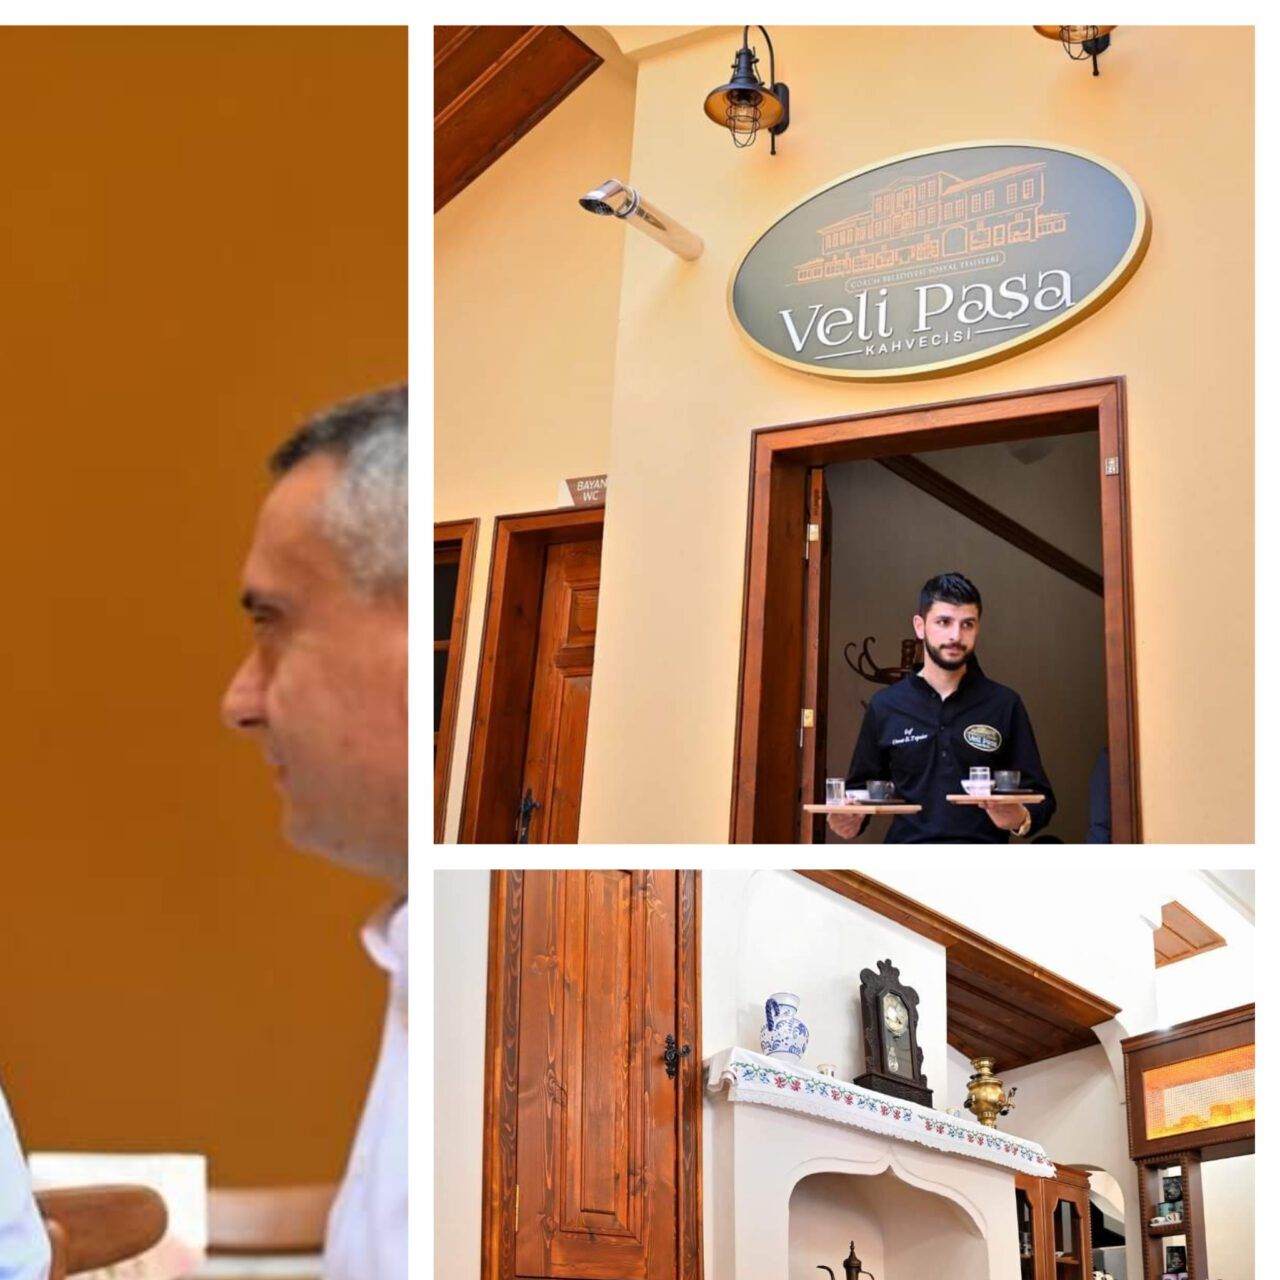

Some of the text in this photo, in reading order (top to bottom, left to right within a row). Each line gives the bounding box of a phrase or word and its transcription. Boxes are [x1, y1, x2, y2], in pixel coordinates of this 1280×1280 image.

[778, 288, 894, 353] Veli
[577, 478, 608, 492] BAYAN
[582, 490, 600, 502] WC
